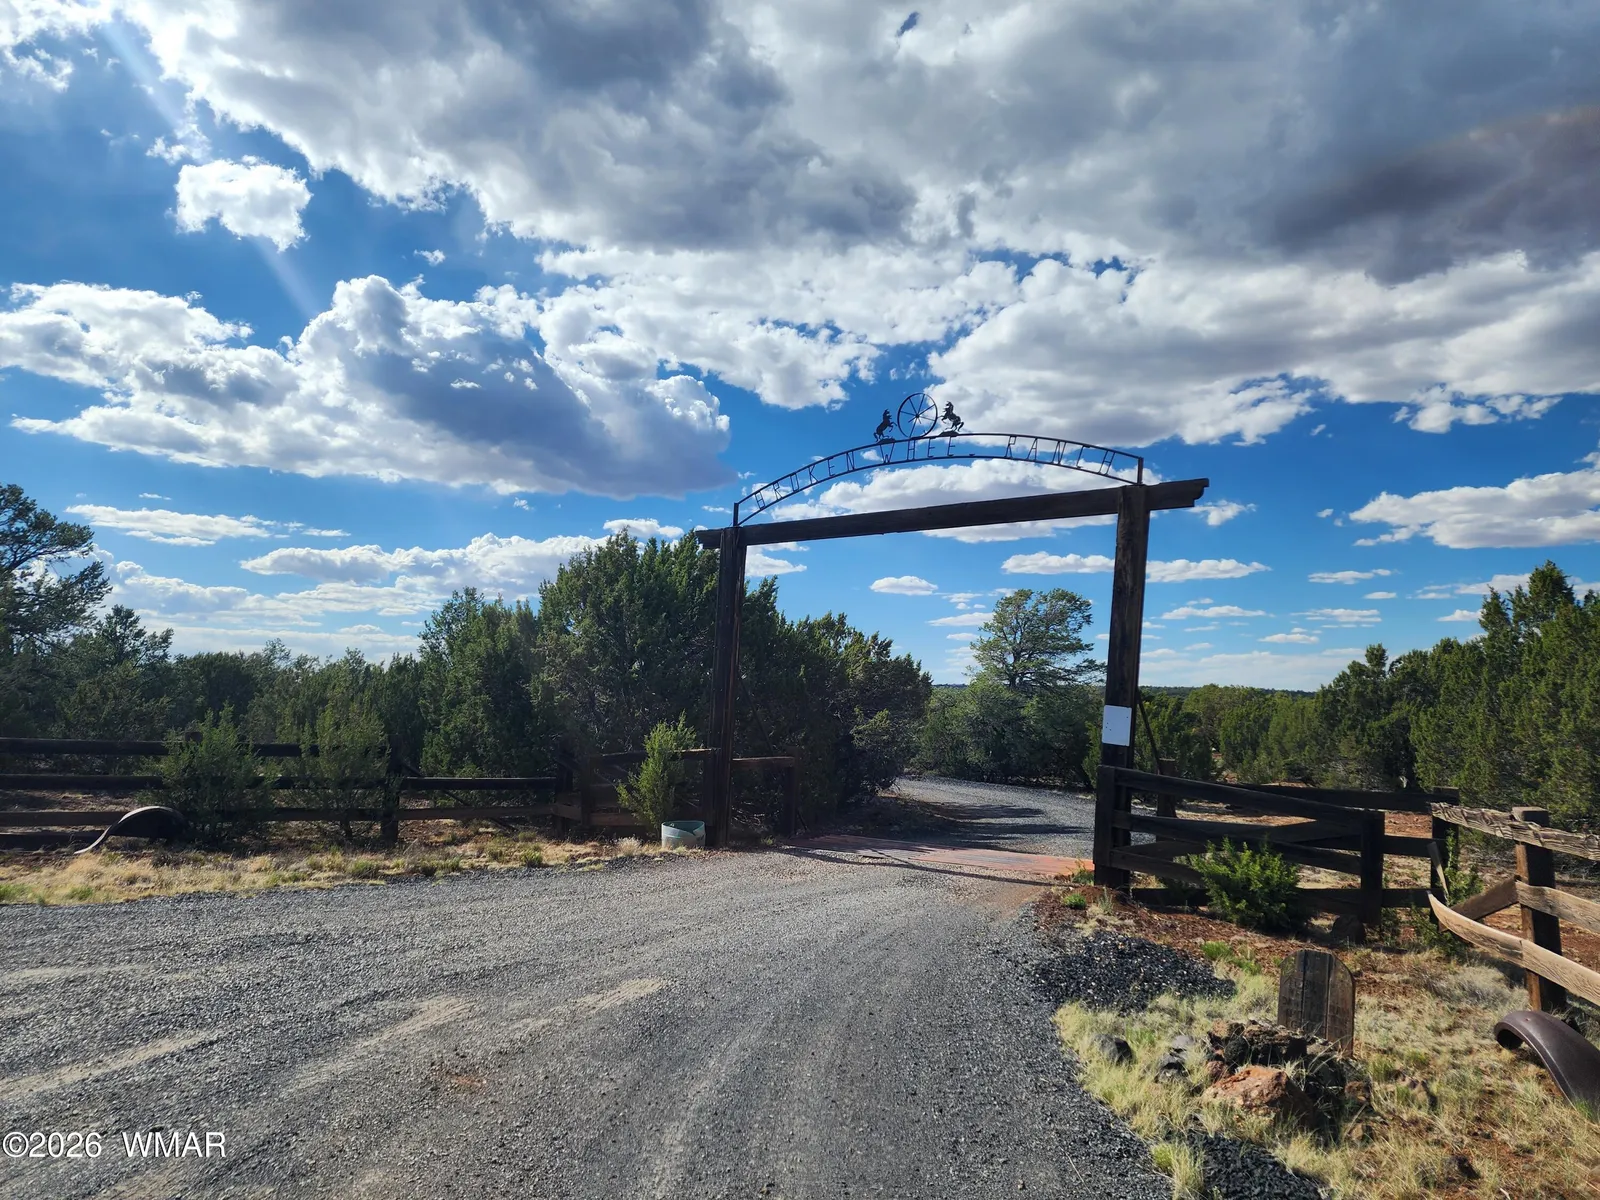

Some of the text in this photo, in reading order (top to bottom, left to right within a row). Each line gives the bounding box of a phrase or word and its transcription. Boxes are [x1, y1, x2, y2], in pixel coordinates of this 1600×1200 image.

[754, 435, 1116, 510] BROKEN WHEE RANCH
